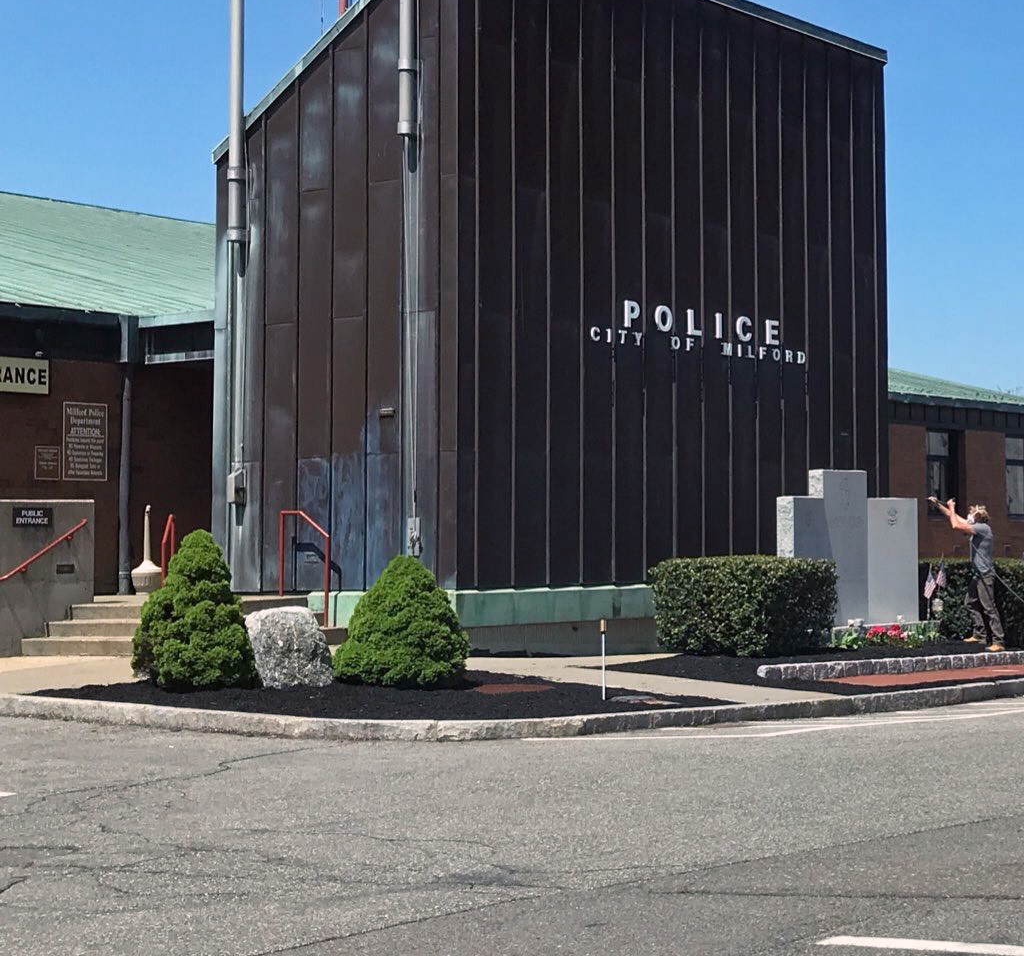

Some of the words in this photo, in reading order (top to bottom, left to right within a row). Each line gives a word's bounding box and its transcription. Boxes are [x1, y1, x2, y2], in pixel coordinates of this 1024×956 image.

[624, 299, 780, 345] POLICE
[590, 326, 643, 346] CITY
[671, 336, 695, 352] OF
[720, 342, 807, 365] MILFORD
[15, 517, 49, 525] ENTRANCE
[21, 509, 44, 517] PUBLIC
